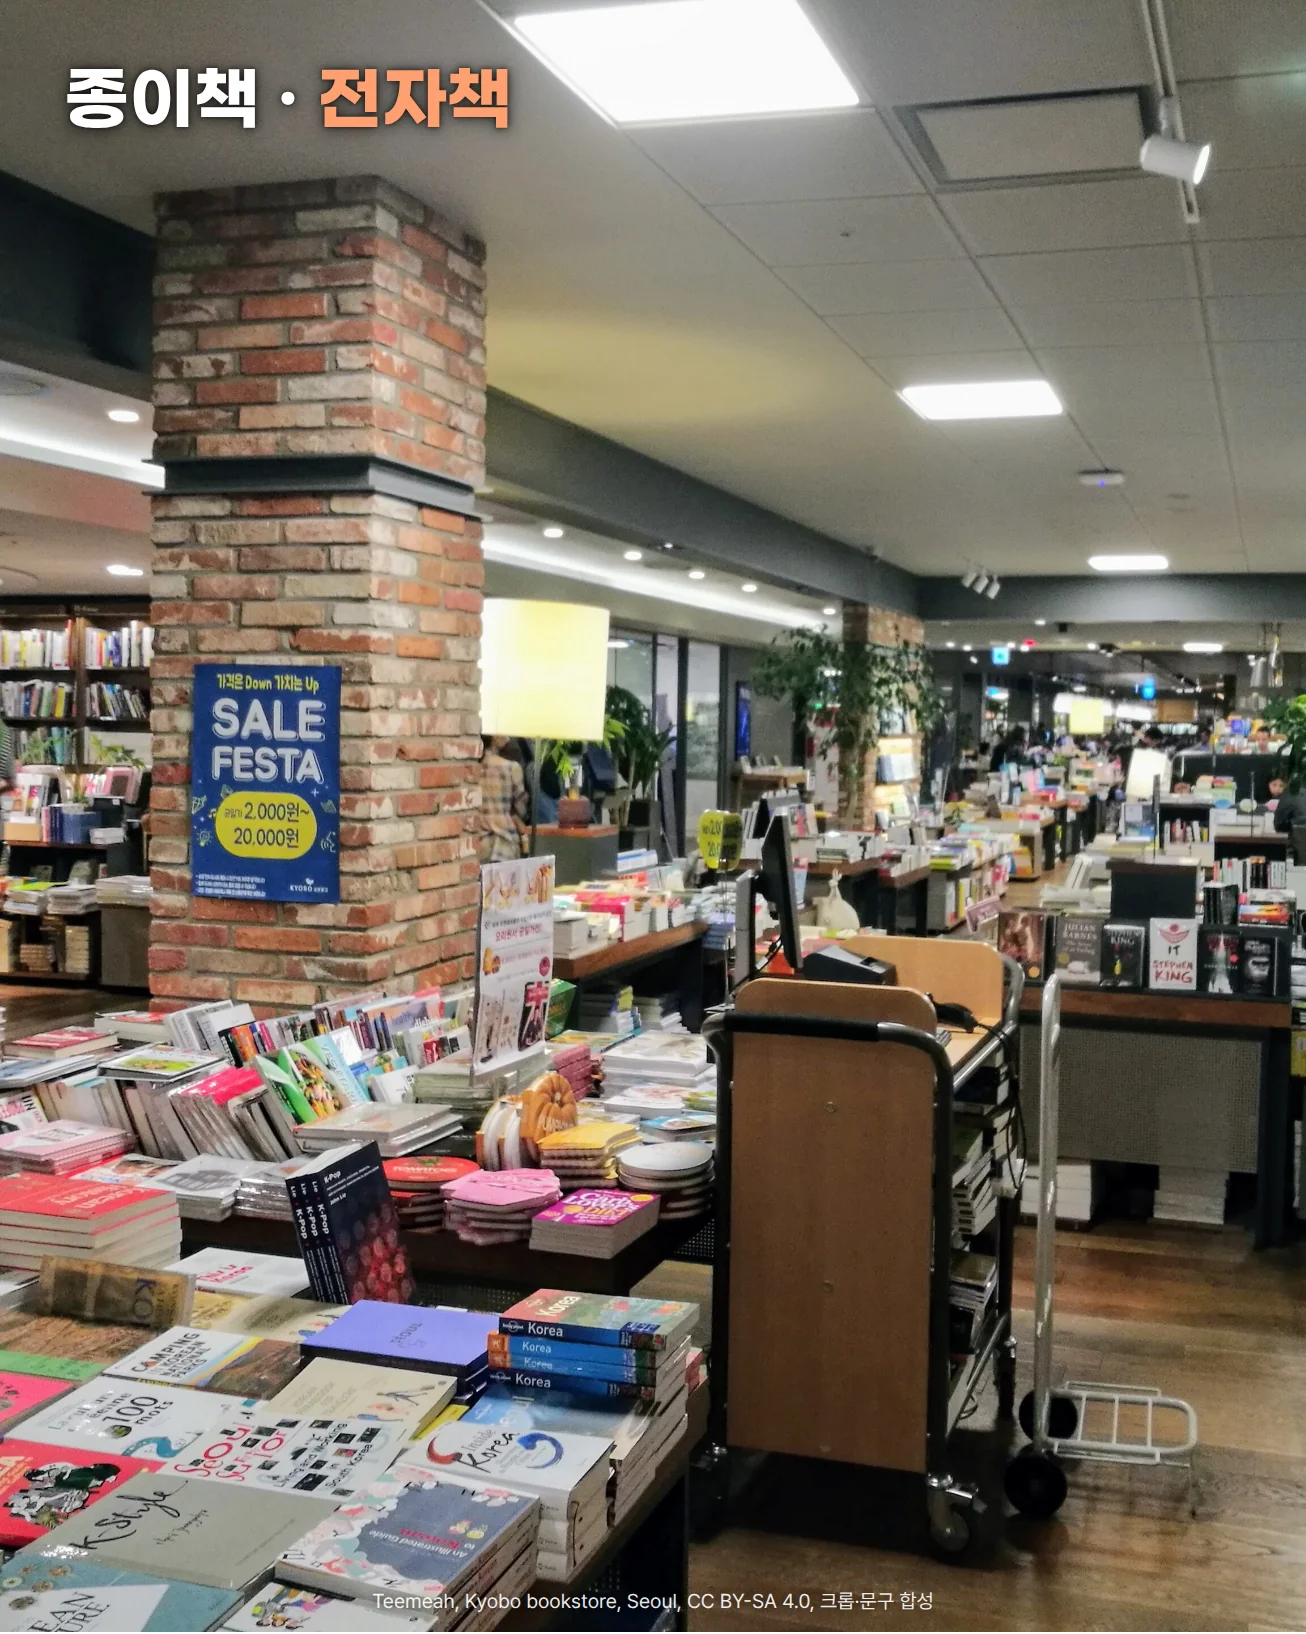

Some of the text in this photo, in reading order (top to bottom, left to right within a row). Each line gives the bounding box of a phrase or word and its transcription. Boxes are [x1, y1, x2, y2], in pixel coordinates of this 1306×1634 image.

[217, 673, 320, 694] 가격은 Down 가치는 Up
[212, 697, 327, 742] SALE
[211, 745, 325, 785] FESTA
[234, 827, 299, 848] 20,000원
[1168, 945, 1180, 955] IT
[1152, 959, 1194, 971] STEPHEN
[1154, 970, 1193, 983] KING
[324, 1171, 341, 1184] K-Pop
[393, 1165, 457, 1174] TOMATOES
[296, 1208, 308, 1240] K-Pop
[306, 1206, 318, 1237] K-Pop
[317, 1203, 329, 1235] K-Pop
[535, 1295, 582, 1317] Korea
[527, 1321, 564, 1337] Korea
[522, 1341, 552, 1353] Korea
[524, 1357, 553, 1370] Korea
[515, 1372, 551, 1388] Korea
[102, 1396, 158, 1422] 100
[134, 1400, 174, 1425] mots
[312, 1423, 348, 1453] Working
[461, 1429, 497, 1452] Inside
[456, 1432, 521, 1474] Korea
[325, 1444, 373, 1488] South Korea
[369, 1529, 468, 1559] An Illustrated Guide
[464, 1542, 476, 1550] to
